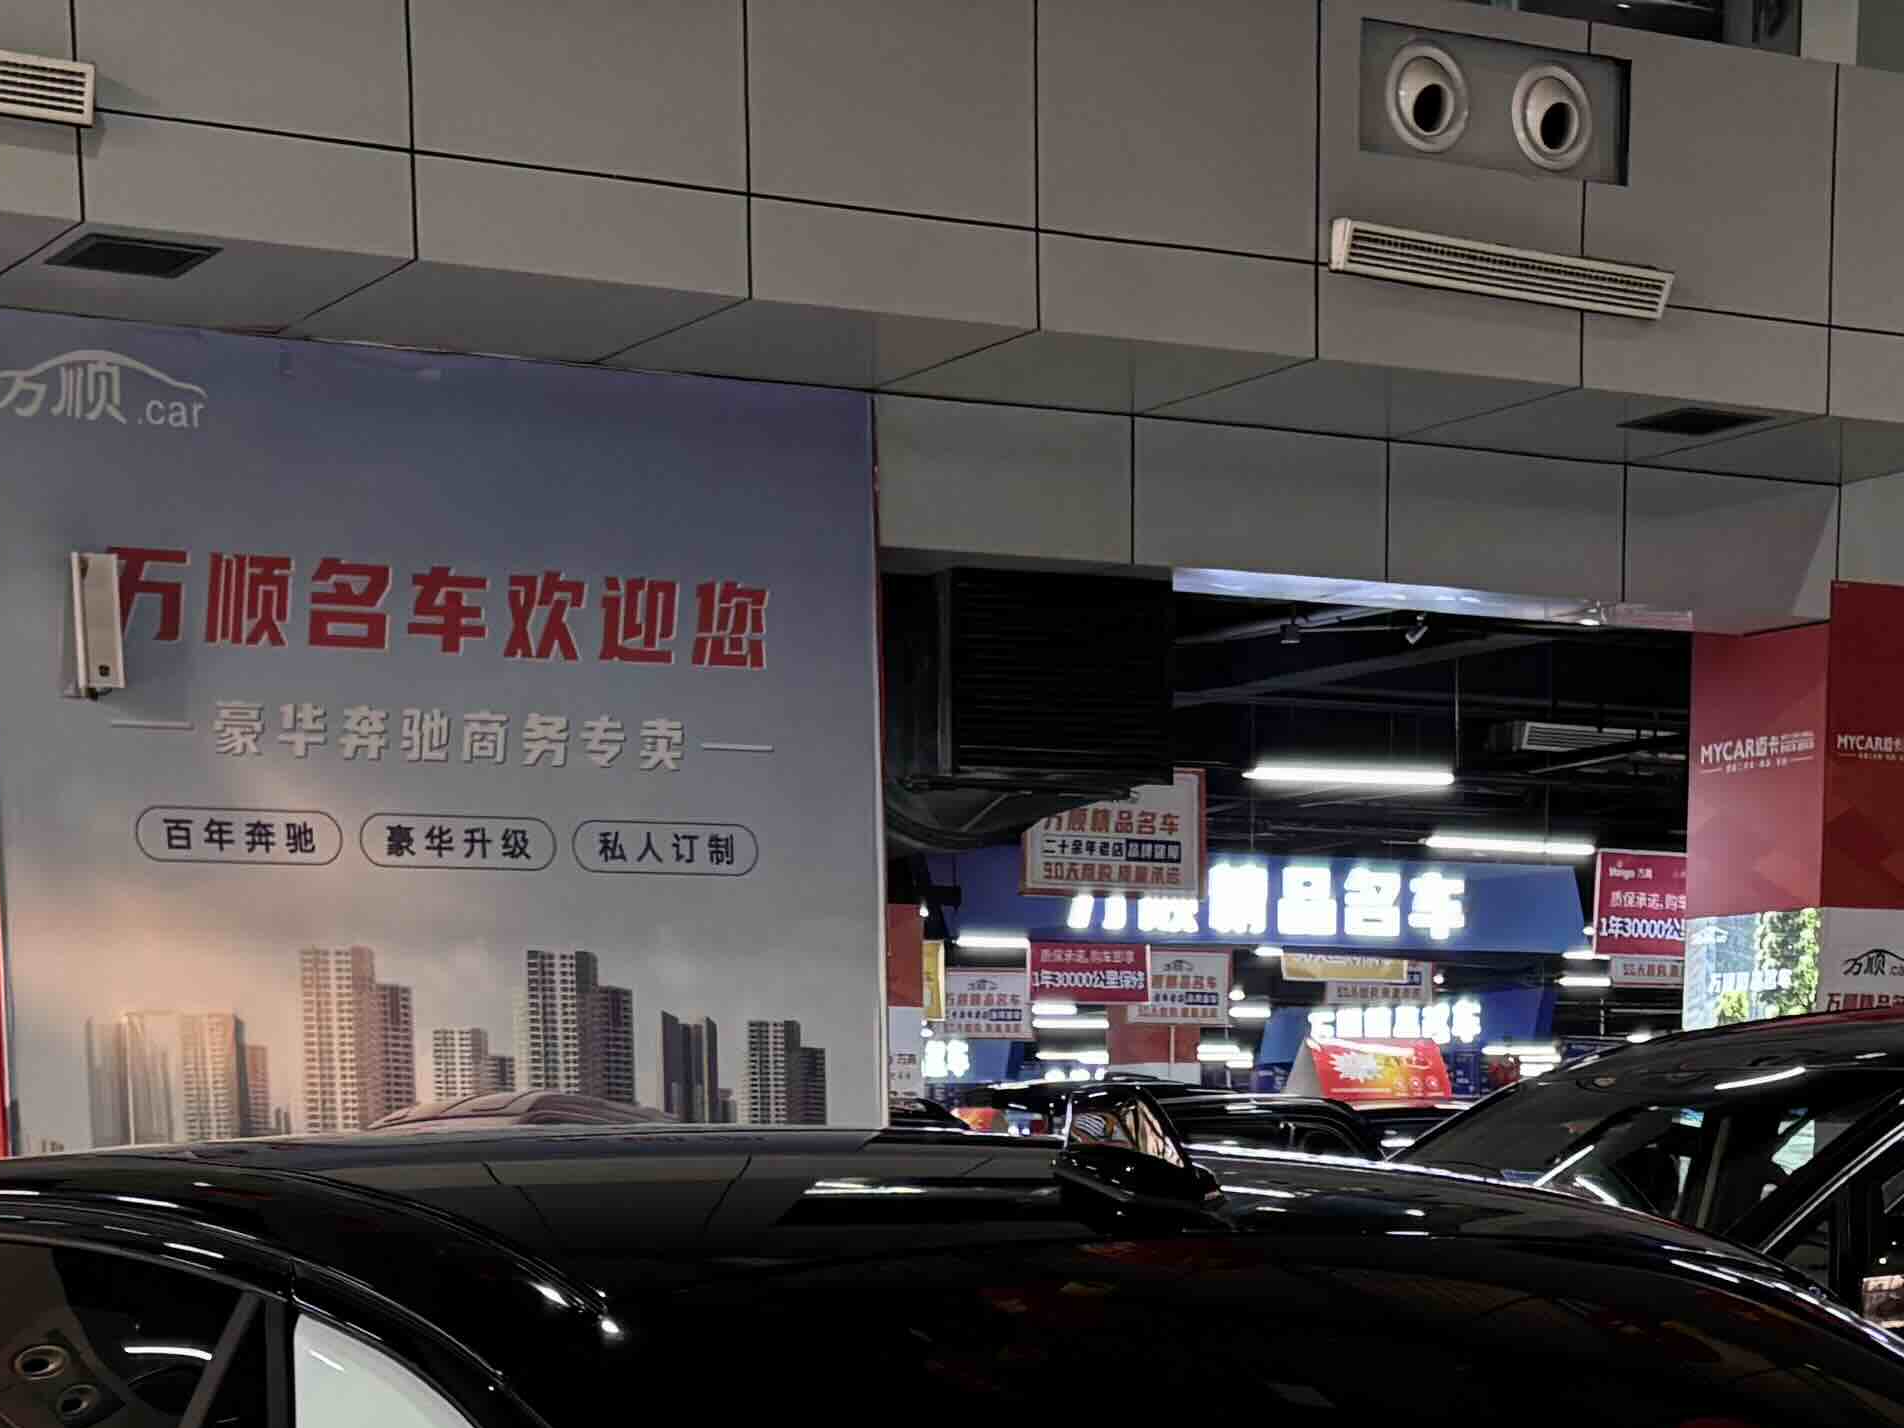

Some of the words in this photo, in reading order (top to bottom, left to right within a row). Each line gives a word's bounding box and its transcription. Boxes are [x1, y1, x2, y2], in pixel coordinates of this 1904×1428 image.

[102, 546, 770, 671] 万顺名车欢迎您
[213, 700, 685, 771] 豪华奔驰商务专卖
[162, 816, 316, 857] 百年奔驰
[385, 823, 533, 862] 豪华升级
[597, 829, 737, 867] 私人订制
